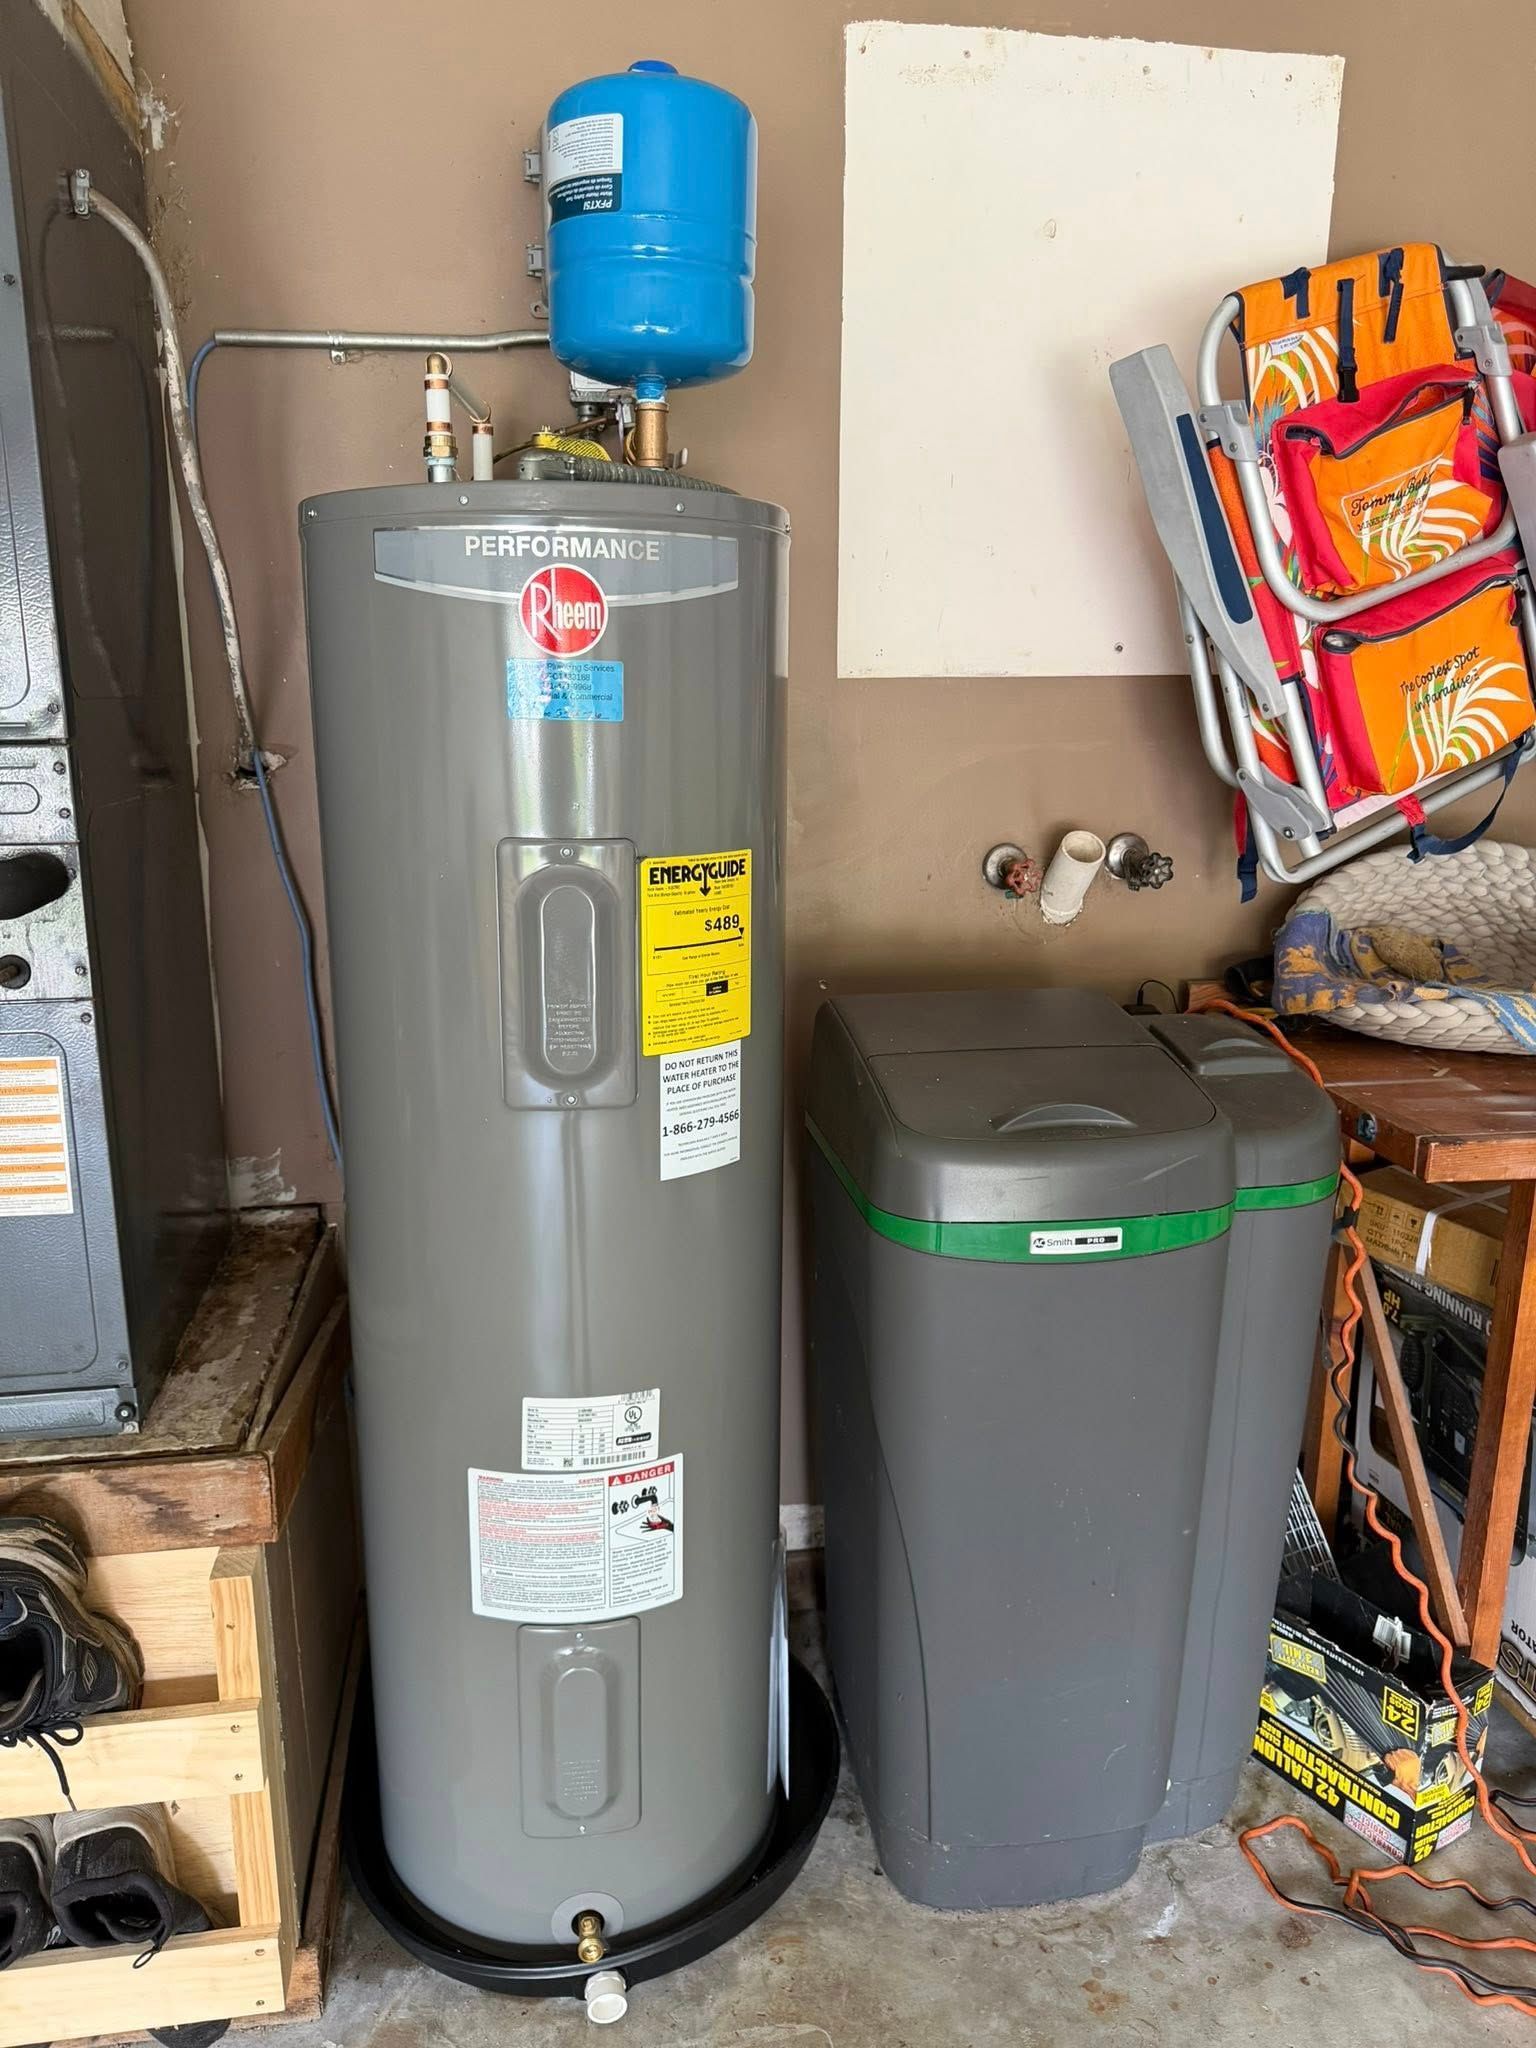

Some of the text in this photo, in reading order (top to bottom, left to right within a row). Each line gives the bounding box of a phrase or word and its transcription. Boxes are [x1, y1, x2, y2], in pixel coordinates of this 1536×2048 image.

[1351, 488, 1406, 517] Tommy
[465, 535, 660, 561] PERFORMANCE
[530, 567, 601, 640] Rheem
[584, 664, 615, 673] Services
[1414, 659, 1453, 689] Coolest
[1453, 645, 1480, 670] Spot
[570, 692, 613, 701] Commercial
[1425, 673, 1472, 707] Paradise
[650, 859, 746, 885] ENERGYGUIDE
[705, 914, 740, 931] $489
[665, 1049, 738, 1070] DO NOT RETURN THIS
[663, 1061, 739, 1083] WATER HEATER TO THE
[667, 1073, 736, 1095] PLACE OF PURCHASE
[662, 1109, 740, 1137] 1-866-279-4566
[1047, 1238, 1073, 1247] Smith
[1384, 1289, 1400, 1310] HP
[1425, 1283, 1482, 1330] RUNNING
[1383, 1303, 1398, 1323] 7.0
[625, 1464, 672, 1482] DANGER
[1476, 1695, 1489, 1711] 24
[1387, 1705, 1415, 1732] 24
[1253, 1734, 1340, 1807] 42 GALLON
[1283, 1735, 1400, 1829] CONTRACTOR
[1415, 1795, 1475, 1839] CONTRACTOR
[1414, 1844, 1432, 1862] 42
